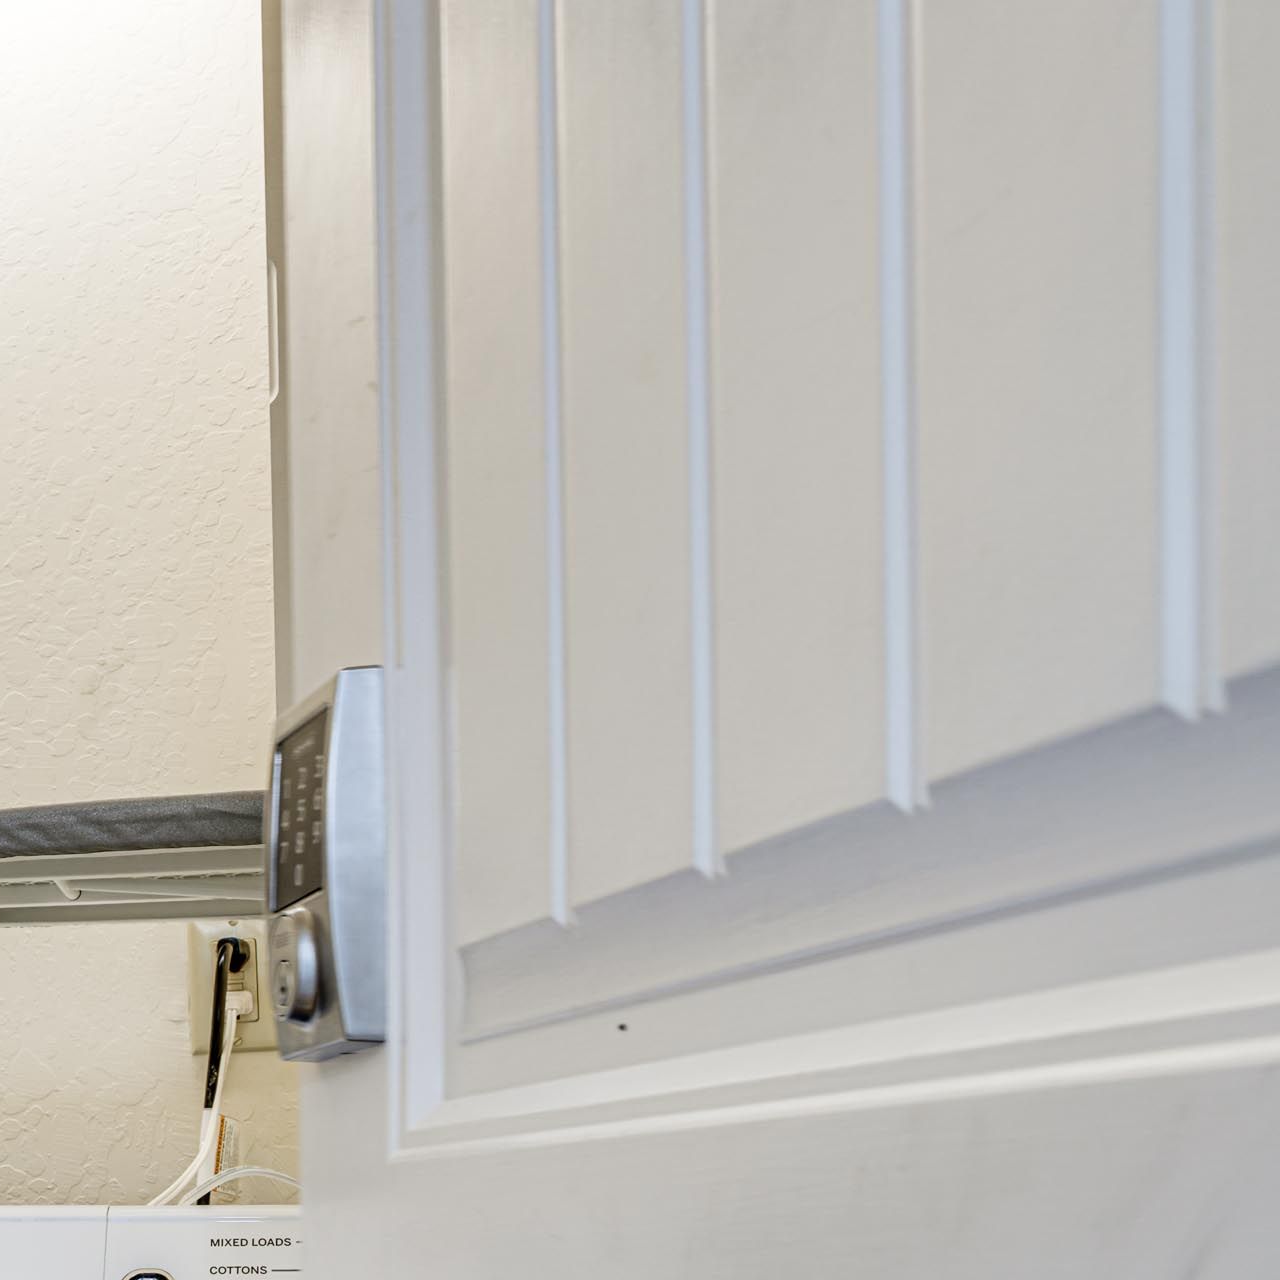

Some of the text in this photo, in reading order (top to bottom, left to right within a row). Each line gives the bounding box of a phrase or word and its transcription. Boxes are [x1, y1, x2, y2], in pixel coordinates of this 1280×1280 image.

[210, 1238, 292, 1247] MIXED LOADS
[209, 1265, 268, 1275] COTTONS
